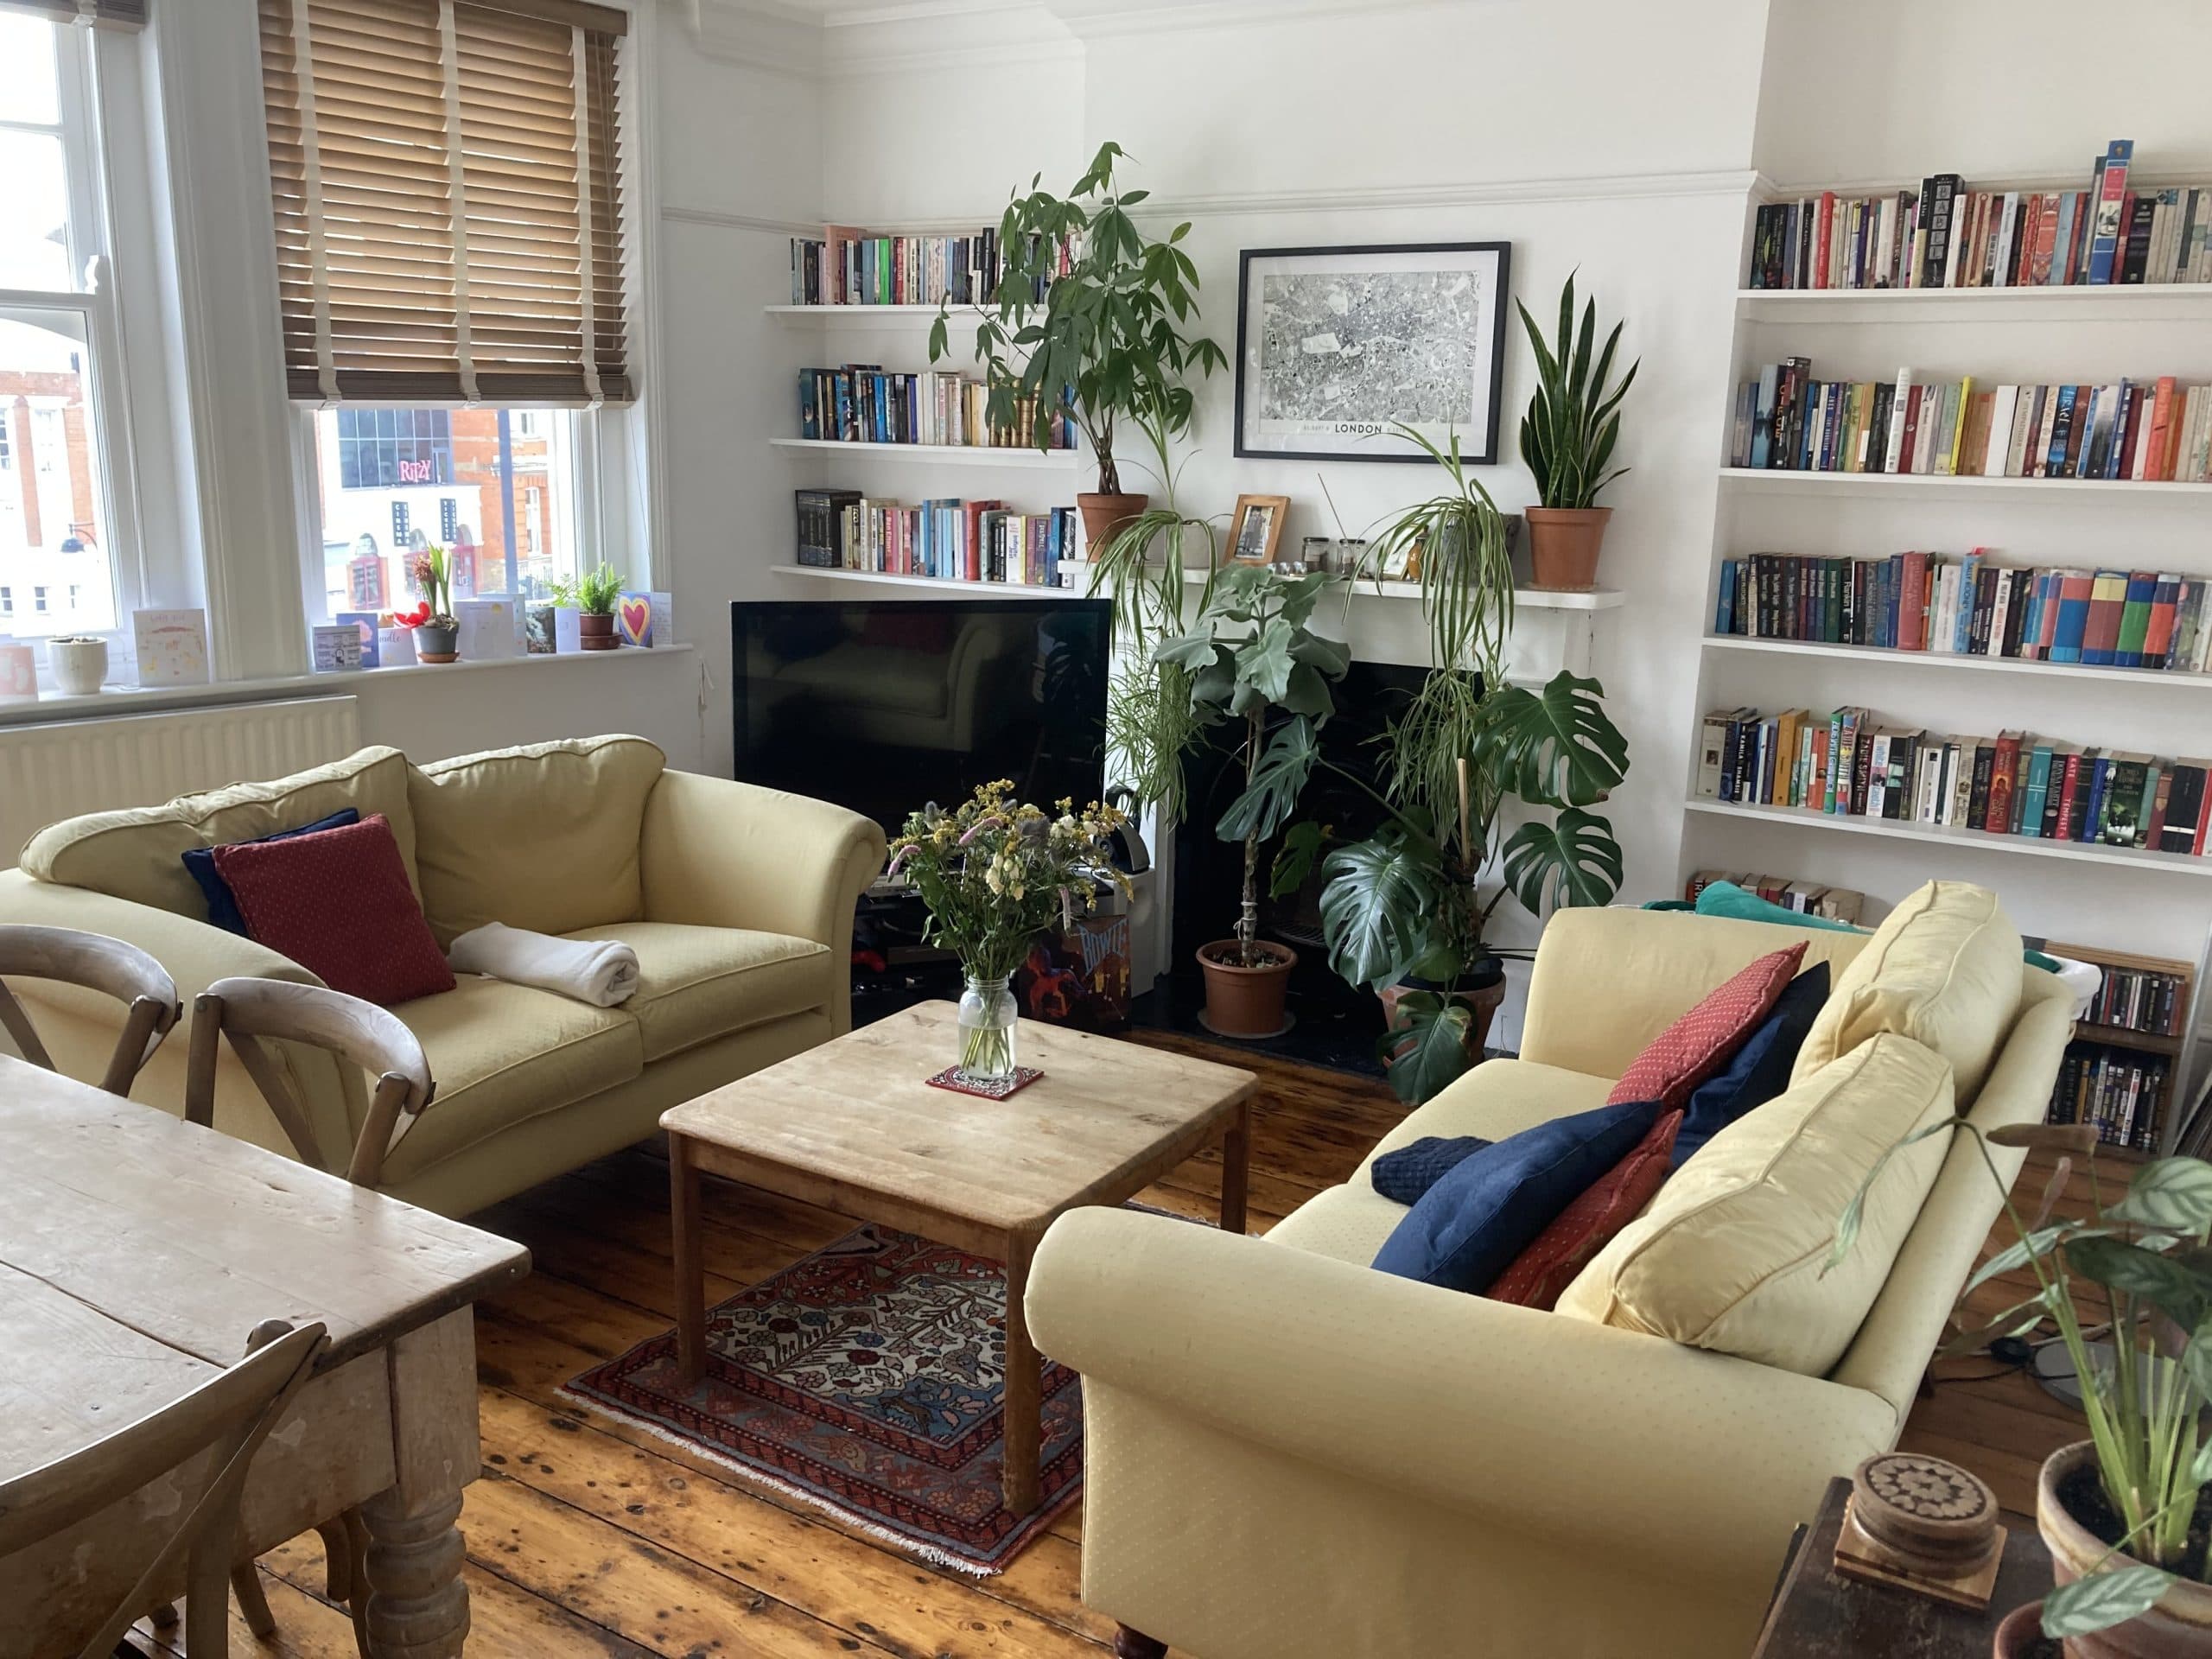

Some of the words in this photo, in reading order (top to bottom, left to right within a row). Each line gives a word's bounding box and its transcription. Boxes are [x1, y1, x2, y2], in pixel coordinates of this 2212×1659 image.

[1335, 423, 1382, 434] LONDON
[399, 460, 430, 482] RITZY
[2068, 758, 2076, 778] KATE
[2061, 798, 2071, 831] TEMPEST
